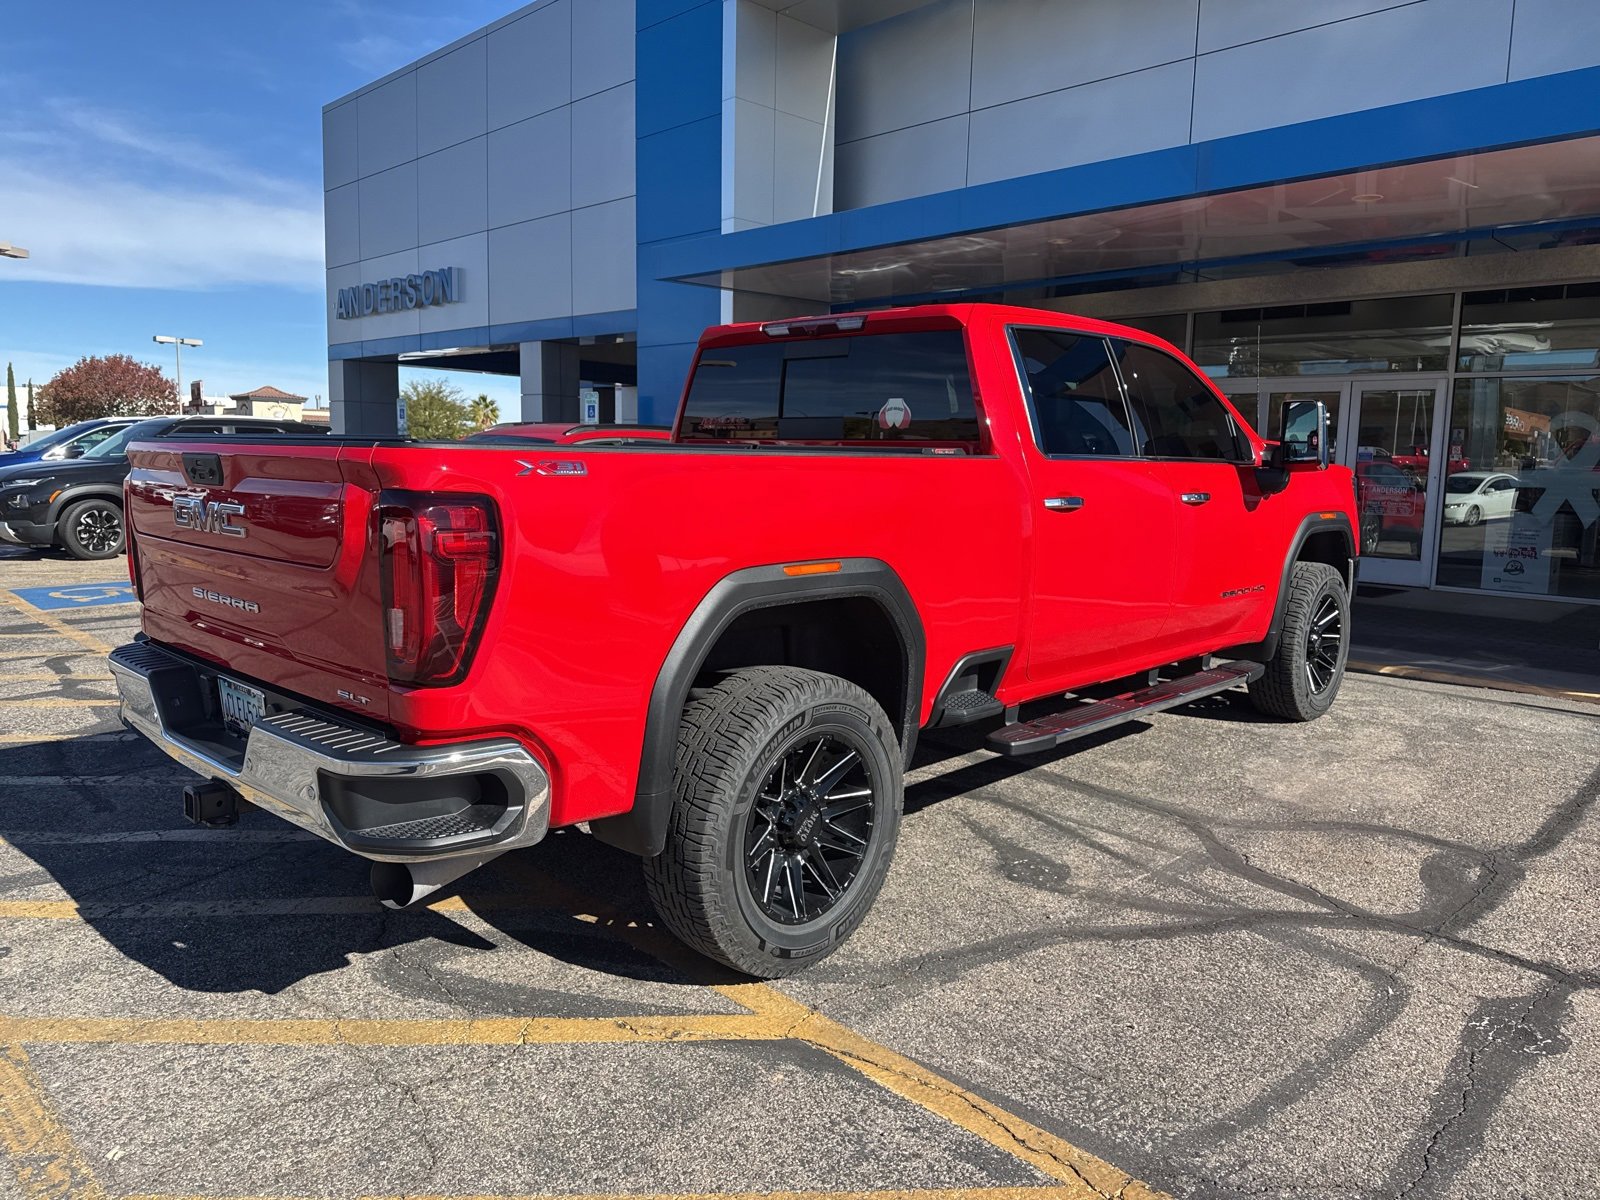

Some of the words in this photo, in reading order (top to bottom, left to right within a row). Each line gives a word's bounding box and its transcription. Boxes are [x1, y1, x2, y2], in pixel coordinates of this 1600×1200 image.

[336, 266, 458, 319] ANDERSON
[173, 497, 246, 538] GMC
[192, 586, 260, 614] SIERRA
[337, 689, 371, 704] SLT
[752, 714, 804, 778] MICHELIN
